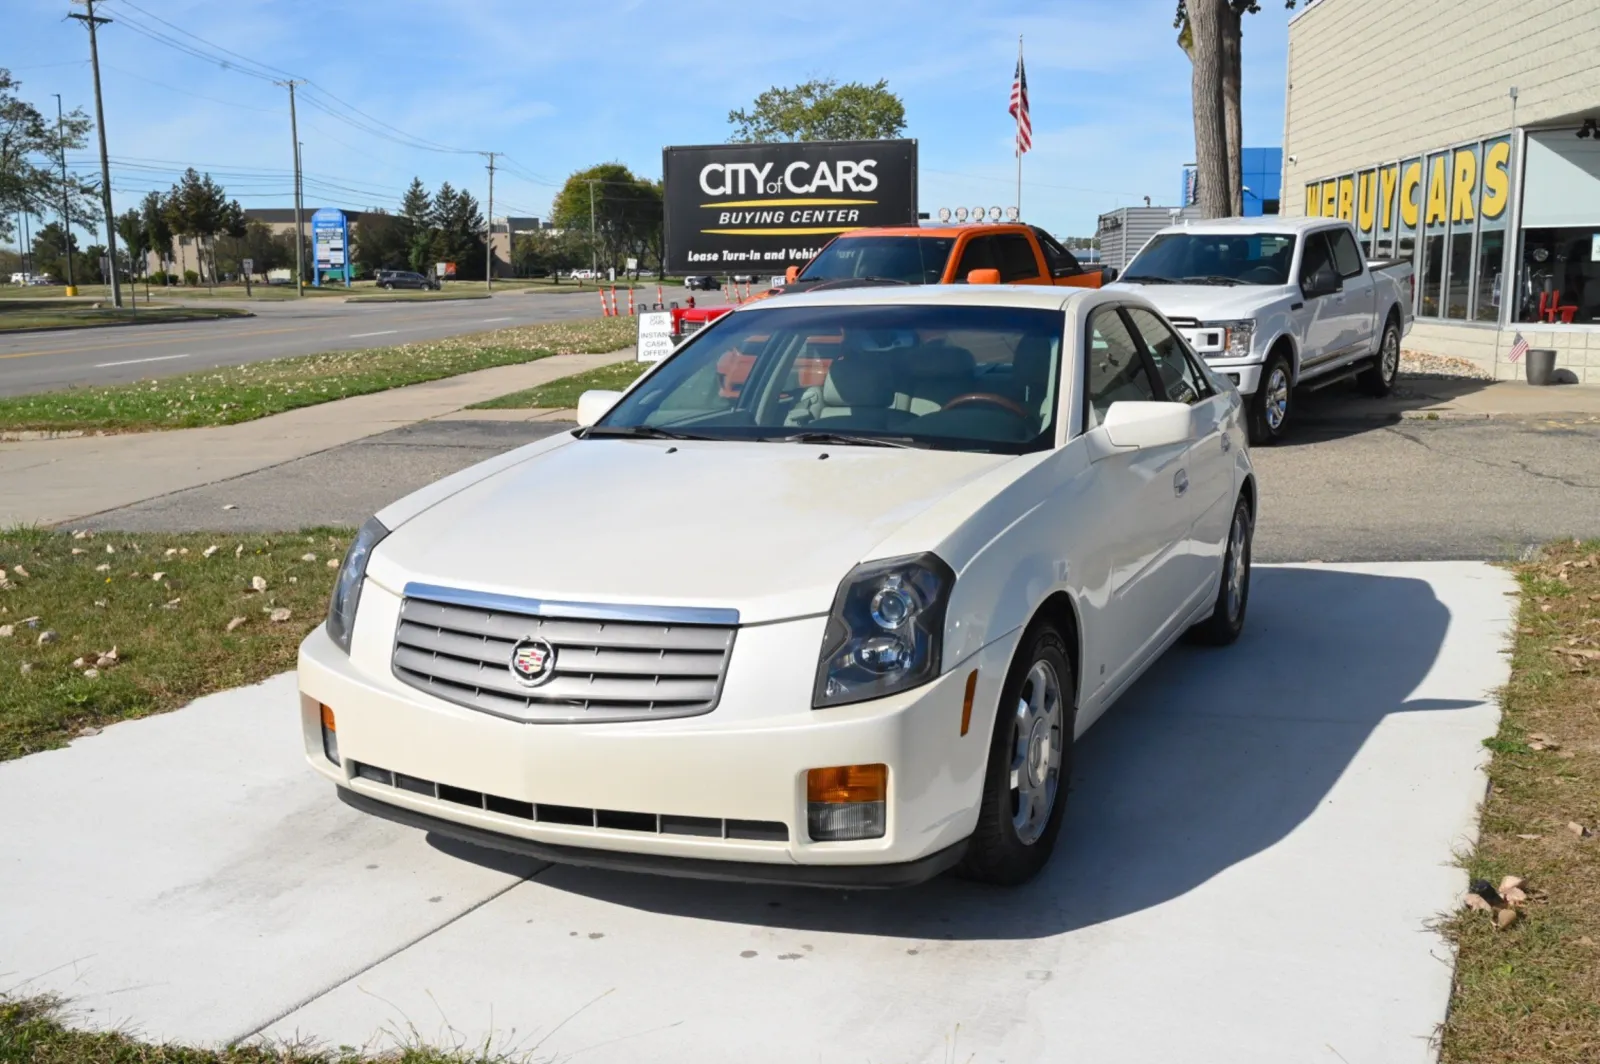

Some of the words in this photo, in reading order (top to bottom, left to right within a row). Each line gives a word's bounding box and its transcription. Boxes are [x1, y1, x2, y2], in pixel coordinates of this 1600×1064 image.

[699, 162, 774, 196] CITY
[766, 175, 784, 194] of
[783, 159, 879, 194] CARS
[719, 211, 785, 225] BUYING
[790, 209, 860, 223] CENTER
[688, 250, 719, 262] Lease
[722, 249, 761, 262] Turn-In
[764, 249, 785, 261] and
[644, 340, 667, 348] CASH
